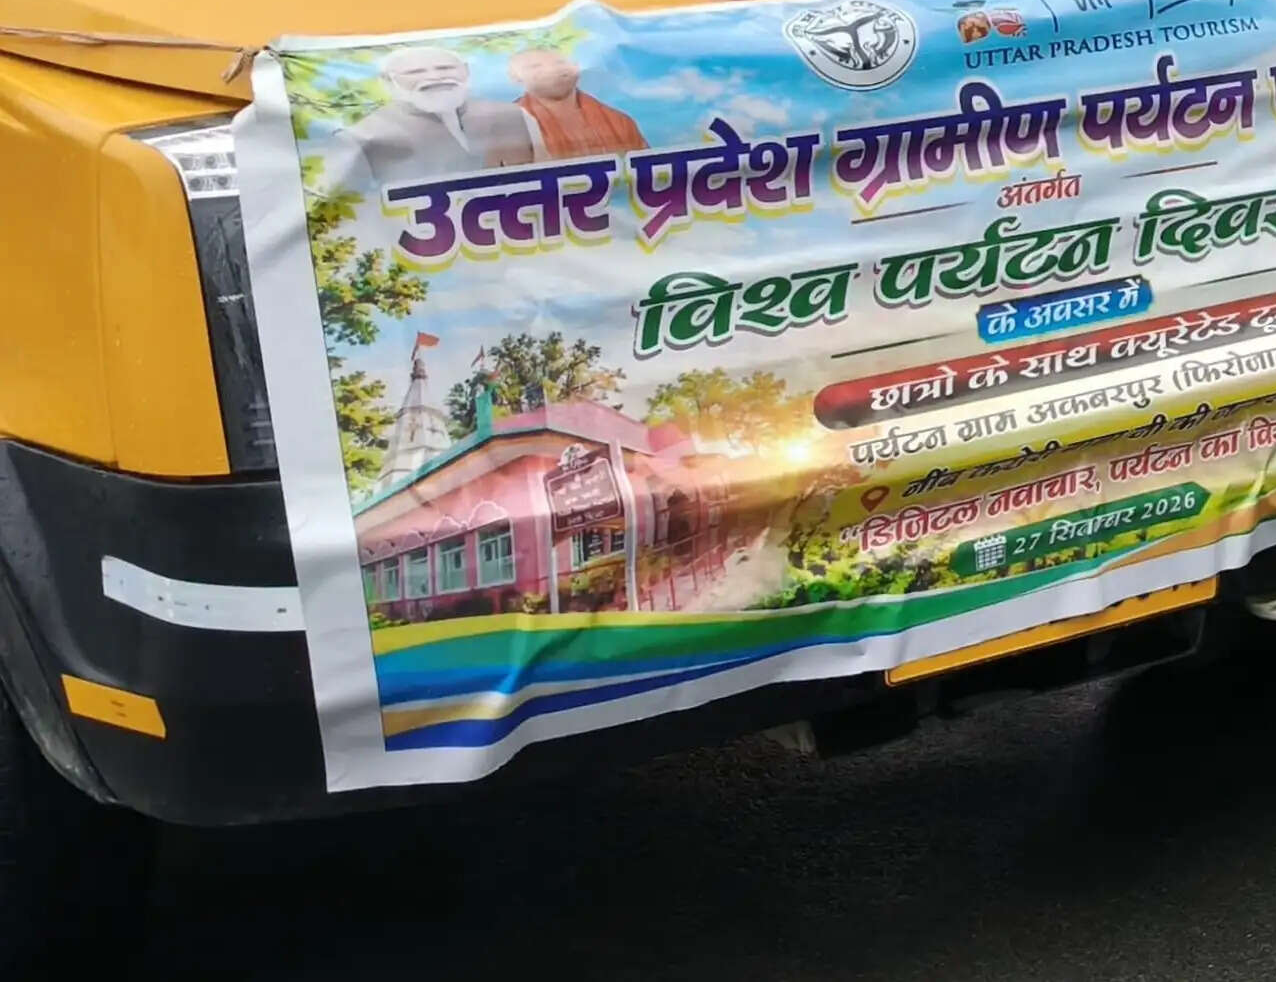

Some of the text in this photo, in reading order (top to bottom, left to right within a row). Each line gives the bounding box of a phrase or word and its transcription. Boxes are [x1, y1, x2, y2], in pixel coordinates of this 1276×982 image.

[964, 17, 1259, 69] UTTAR PRADESH TOURISM
[386, 157, 618, 259] उत्तर
[629, 116, 820, 240] प्रदेश
[835, 81, 1068, 204] ग्रामीण
[1080, 54, 1258, 149] पर्यटन
[997, 170, 1082, 210] अंतर्गत
[638, 263, 859, 352] विश्व
[878, 216, 1120, 301] पर्यटन
[986, 277, 1142, 335] के अवसर में
[869, 366, 958, 412] छात्रो
[967, 356, 1010, 389] के
[1019, 344, 1099, 379] साथ
[1109, 311, 1241, 359] क्यूरेटेड
[850, 426, 947, 465] पर्यटन
[954, 408, 1018, 442] ग्राम
[1027, 374, 1163, 425] अकबरपुर
[1109, 442, 1194, 482] पर्यटन
[1201, 429, 1241, 460] का
[1012, 532, 1041, 555] 27
[1141, 491, 1196, 520] 2026
